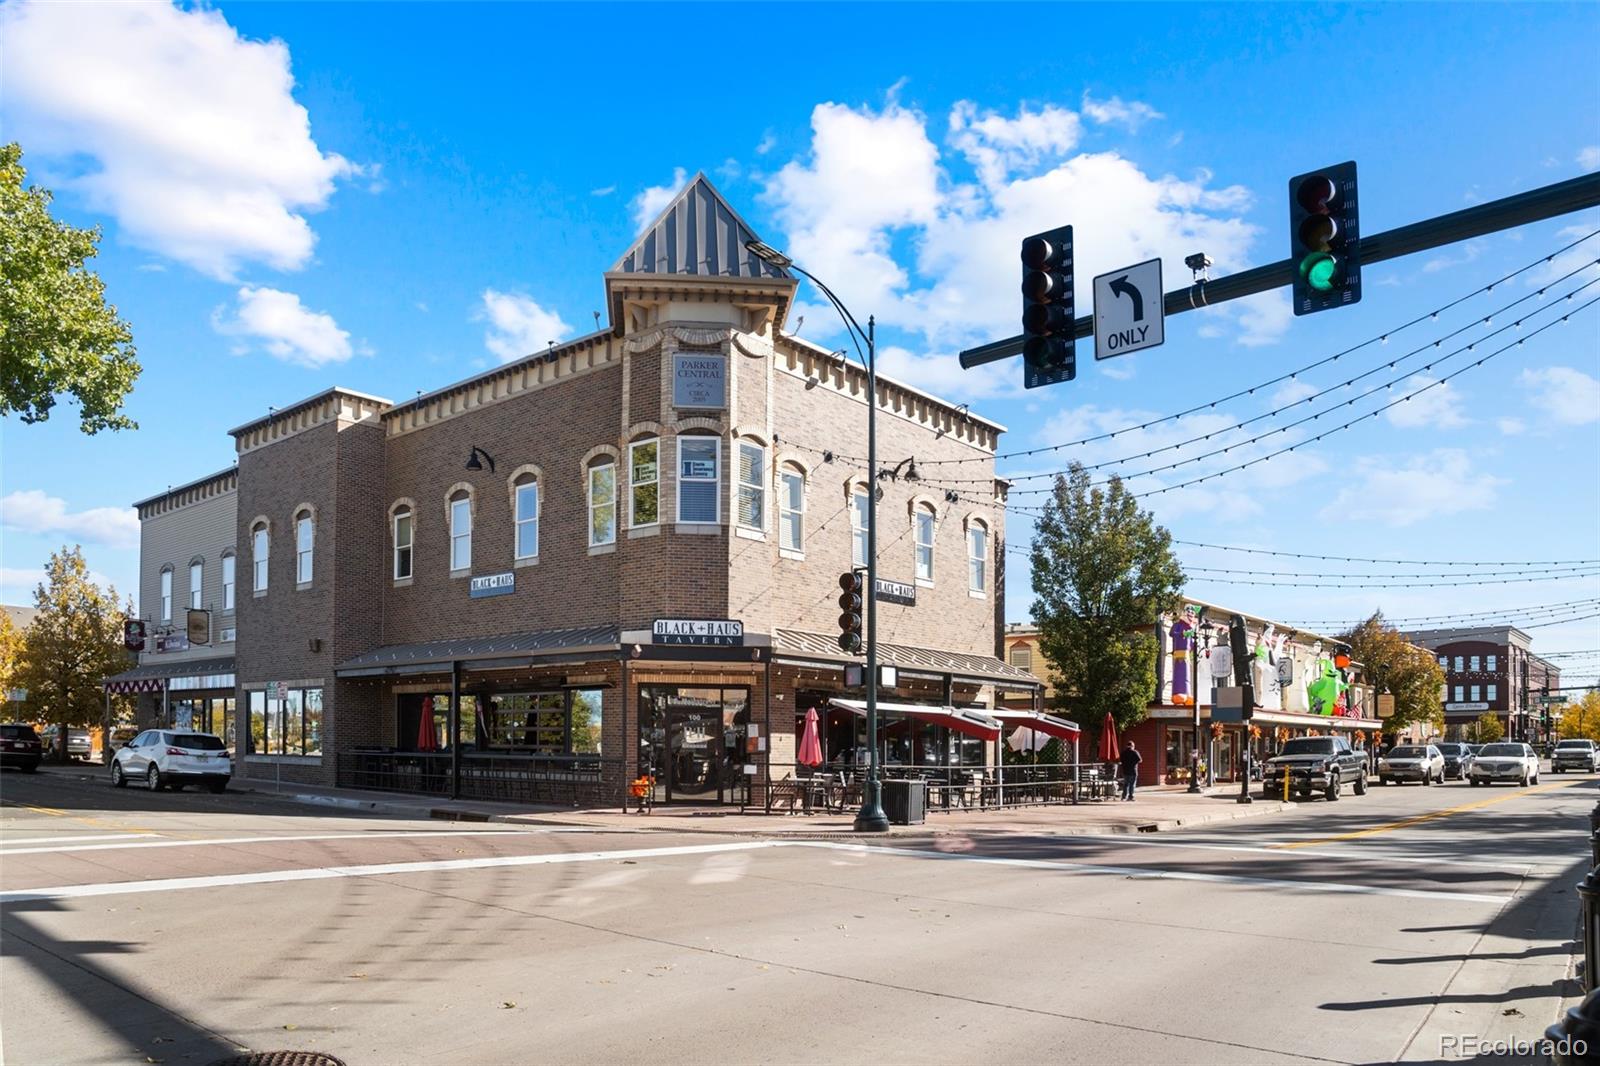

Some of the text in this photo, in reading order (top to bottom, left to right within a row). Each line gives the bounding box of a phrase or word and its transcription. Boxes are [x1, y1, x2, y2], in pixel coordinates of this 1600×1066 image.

[1108, 325, 1149, 350] ONLY
[681, 360, 719, 370] PARKER
[678, 370, 721, 379] CENTRAL
[662, 635, 734, 644] TAVERN
